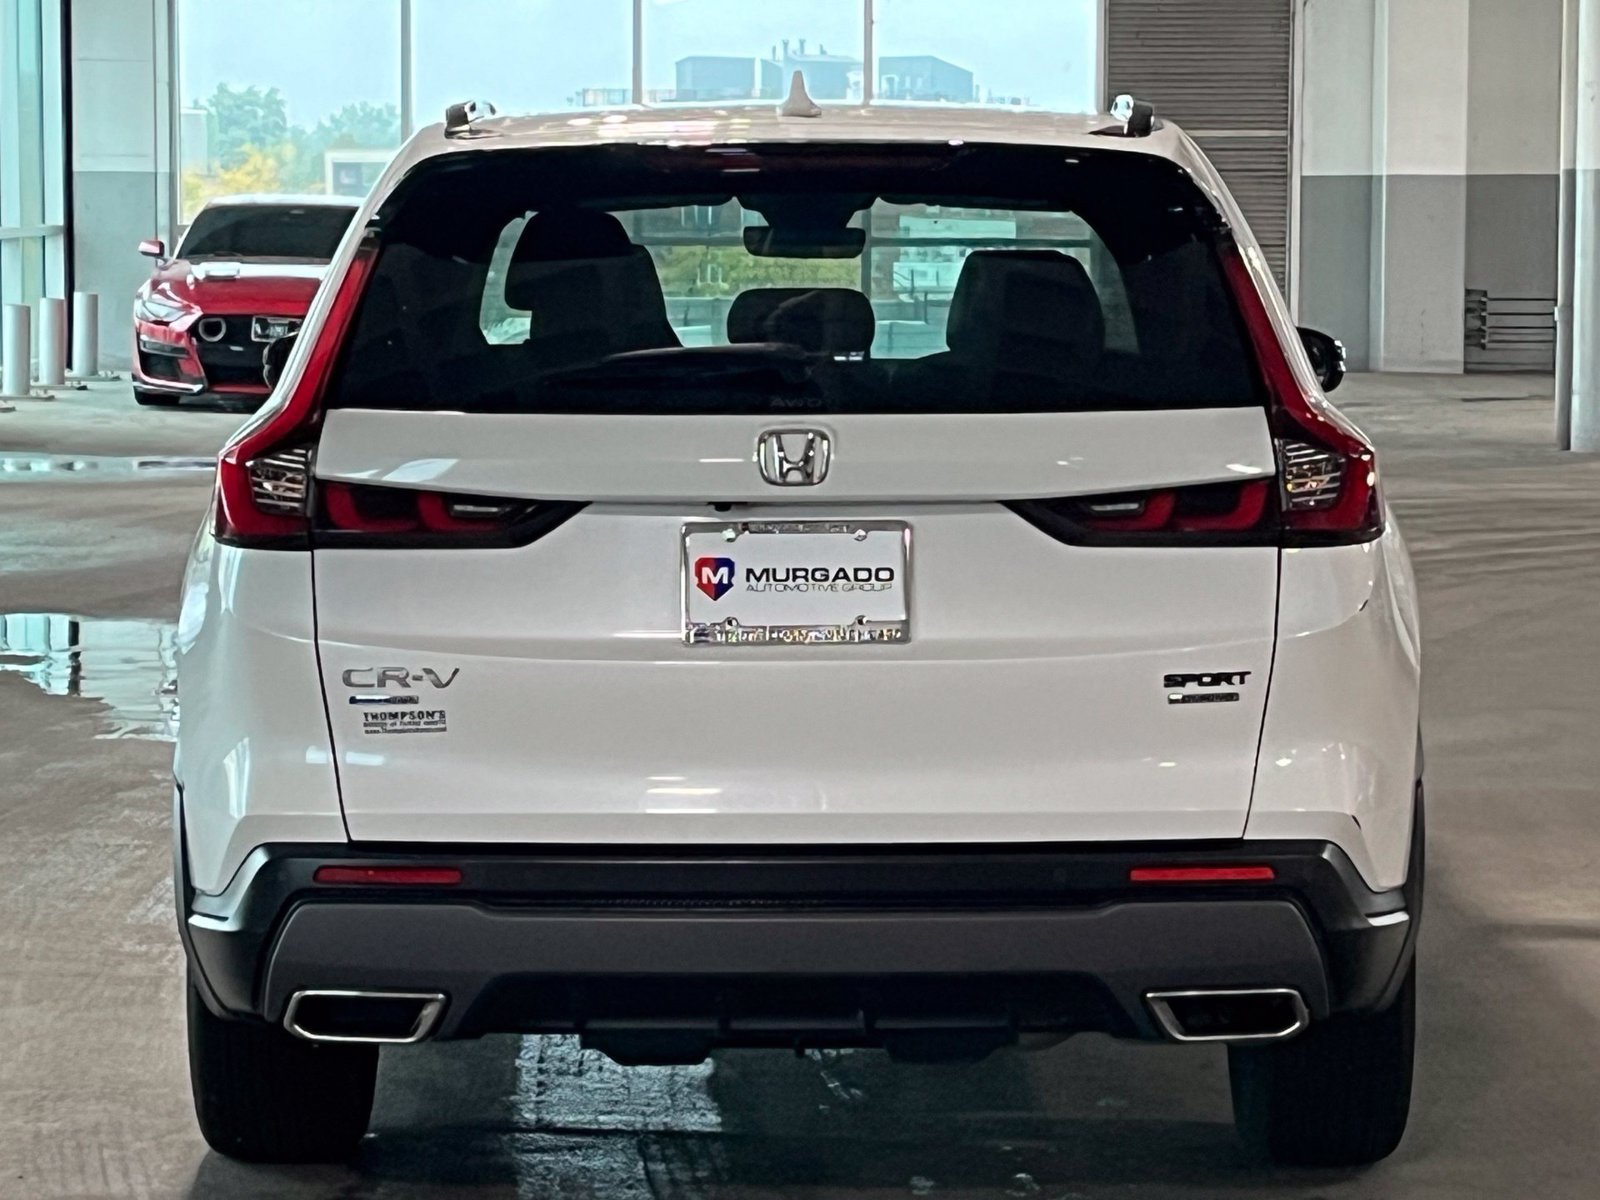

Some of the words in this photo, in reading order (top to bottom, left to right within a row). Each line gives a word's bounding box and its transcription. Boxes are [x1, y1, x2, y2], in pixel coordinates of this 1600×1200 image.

[701, 566, 729, 585] M
[745, 567, 895, 583] MURGADO
[745, 583, 839, 593] AUTOMOTIVE
[841, 583, 893, 592] GROUP
[342, 666, 460, 689] CR-V
[1163, 671, 1252, 688] SPORT
